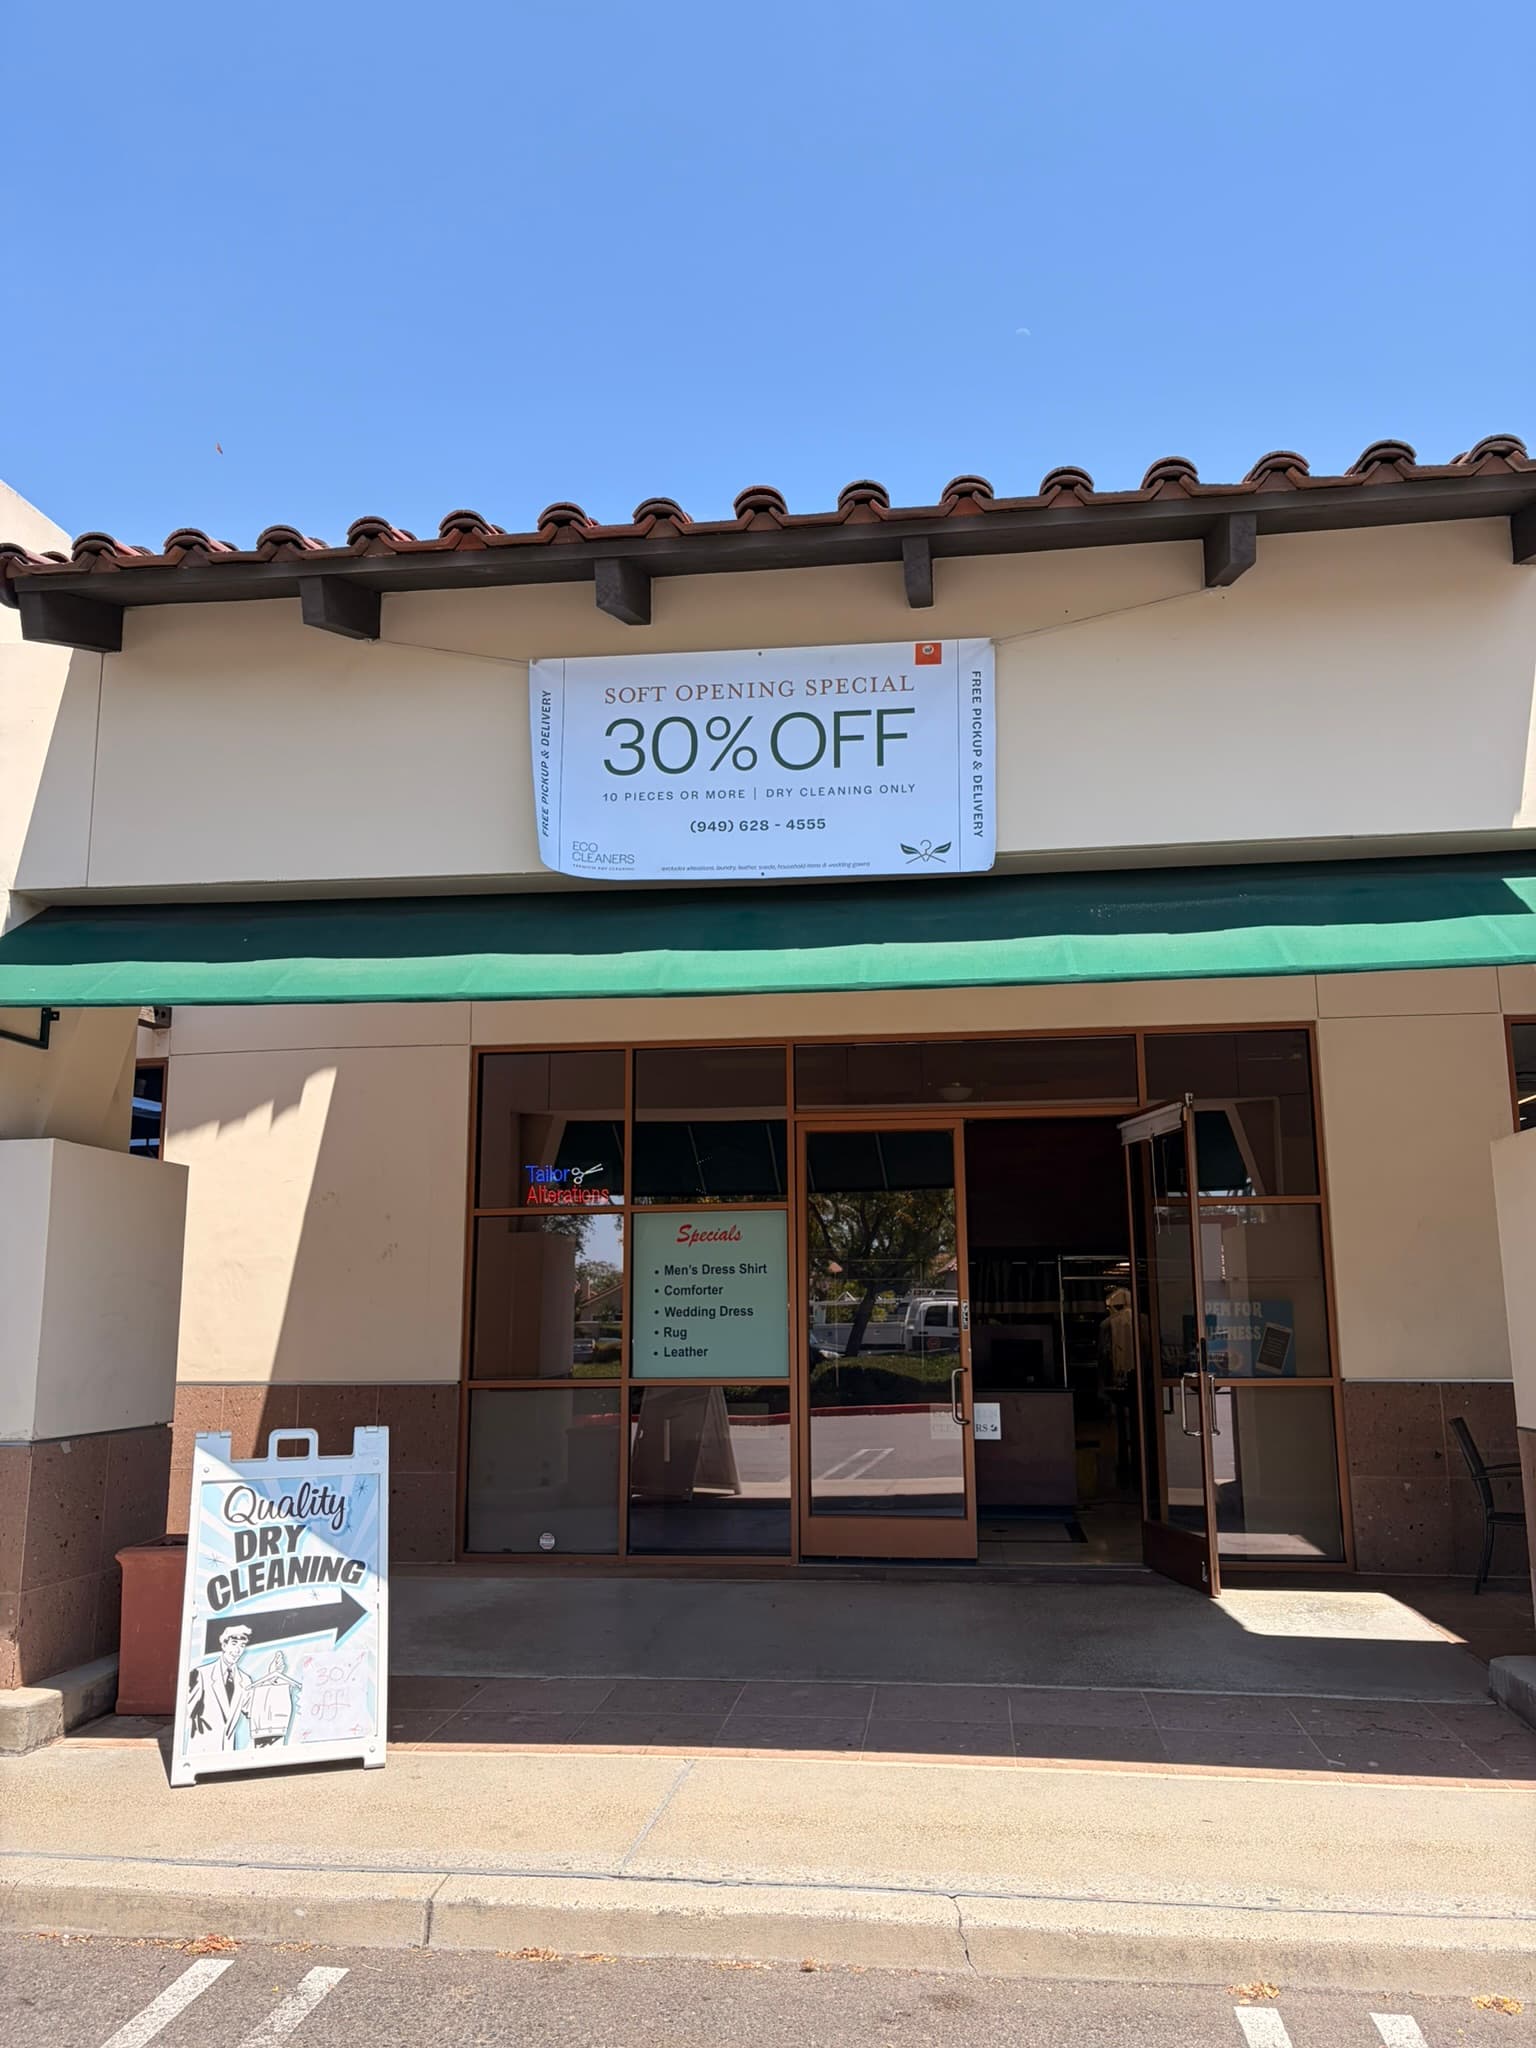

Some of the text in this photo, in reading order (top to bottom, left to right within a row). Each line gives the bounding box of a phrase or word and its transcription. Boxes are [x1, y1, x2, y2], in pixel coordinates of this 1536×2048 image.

[604, 675, 915, 704] SOFT OPENING SPECIAL
[603, 707, 915, 776] 30% OFF
[971, 671, 984, 838] FREE PICKUP & DELIVERY
[540, 690, 551, 838] FREE PICKUP & DELIVERY
[602, 783, 916, 802] 10 PIECES OR MORE DRY CLEANING ONLY
[690, 820, 734, 833] (949)
[739, 820, 769, 832] 628
[785, 818, 826, 831] 4555
[572, 841, 598, 853] ECO
[572, 851, 635, 864] CLEANERS
[524, 1165, 570, 1183] Tailor
[526, 1185, 609, 1204] Alterations
[676, 1224, 742, 1247] Specials
[664, 1263, 768, 1276] Men's Dress Shirt
[664, 1284, 724, 1296] Comforter
[664, 1305, 754, 1320] Wedding Dress
[1205, 1301, 1232, 1317] PEN
[663, 1327, 688, 1340] Rug
[663, 1346, 709, 1358] Leather
[224, 1482, 346, 1530] Quality
[234, 1524, 306, 1562] DRY
[207, 1555, 366, 1612] CLEANING
